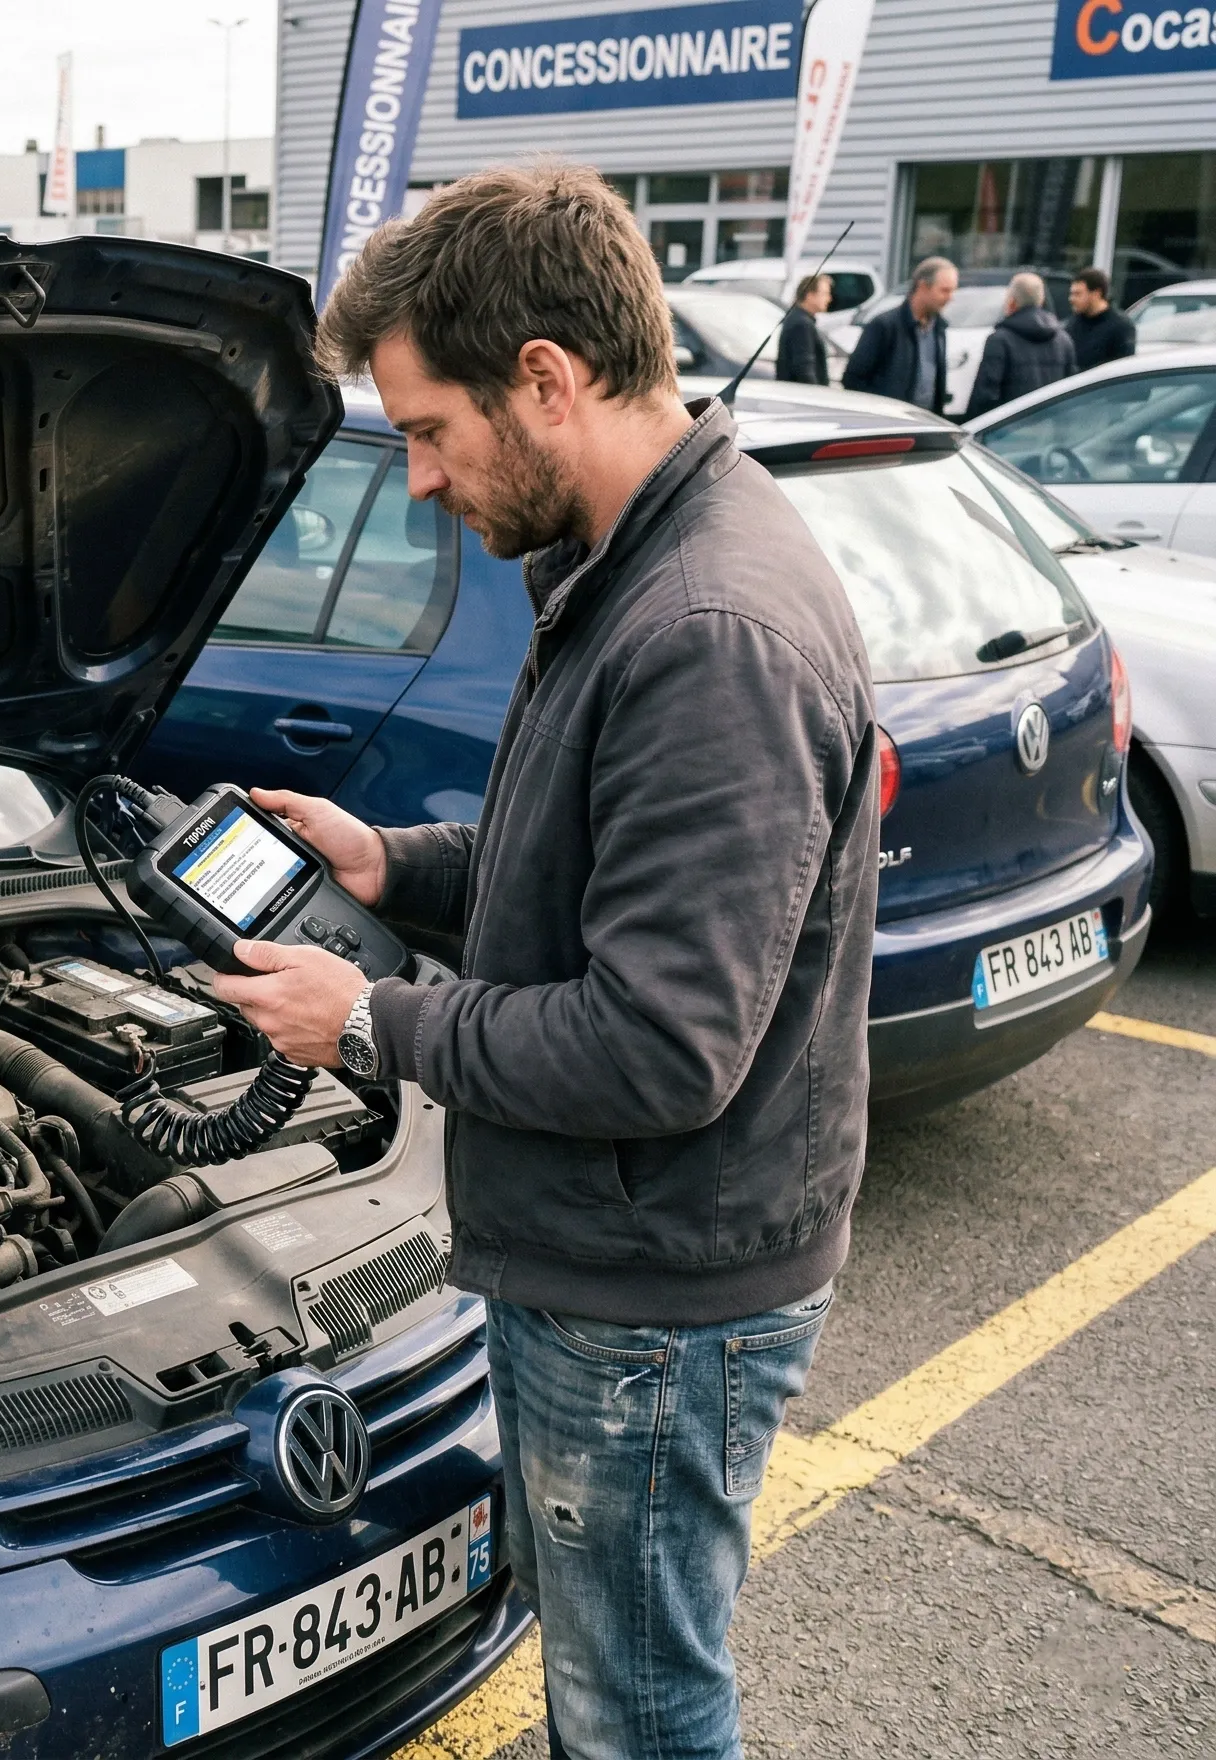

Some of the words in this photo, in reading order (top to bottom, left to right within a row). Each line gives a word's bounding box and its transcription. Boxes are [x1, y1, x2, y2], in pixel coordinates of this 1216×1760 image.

[463, 22, 794, 94] CONCESSIONNAIRE
[1076, 0, 1216, 56] Coca
[337, 0, 422, 276] NCESSIONNAI
[987, 946, 1020, 993] FR
[1024, 929, 1064, 977] 843
[1069, 917, 1092, 960] AB
[175, 1700, 187, 1725] F
[470, 1541, 490, 1580] 75
